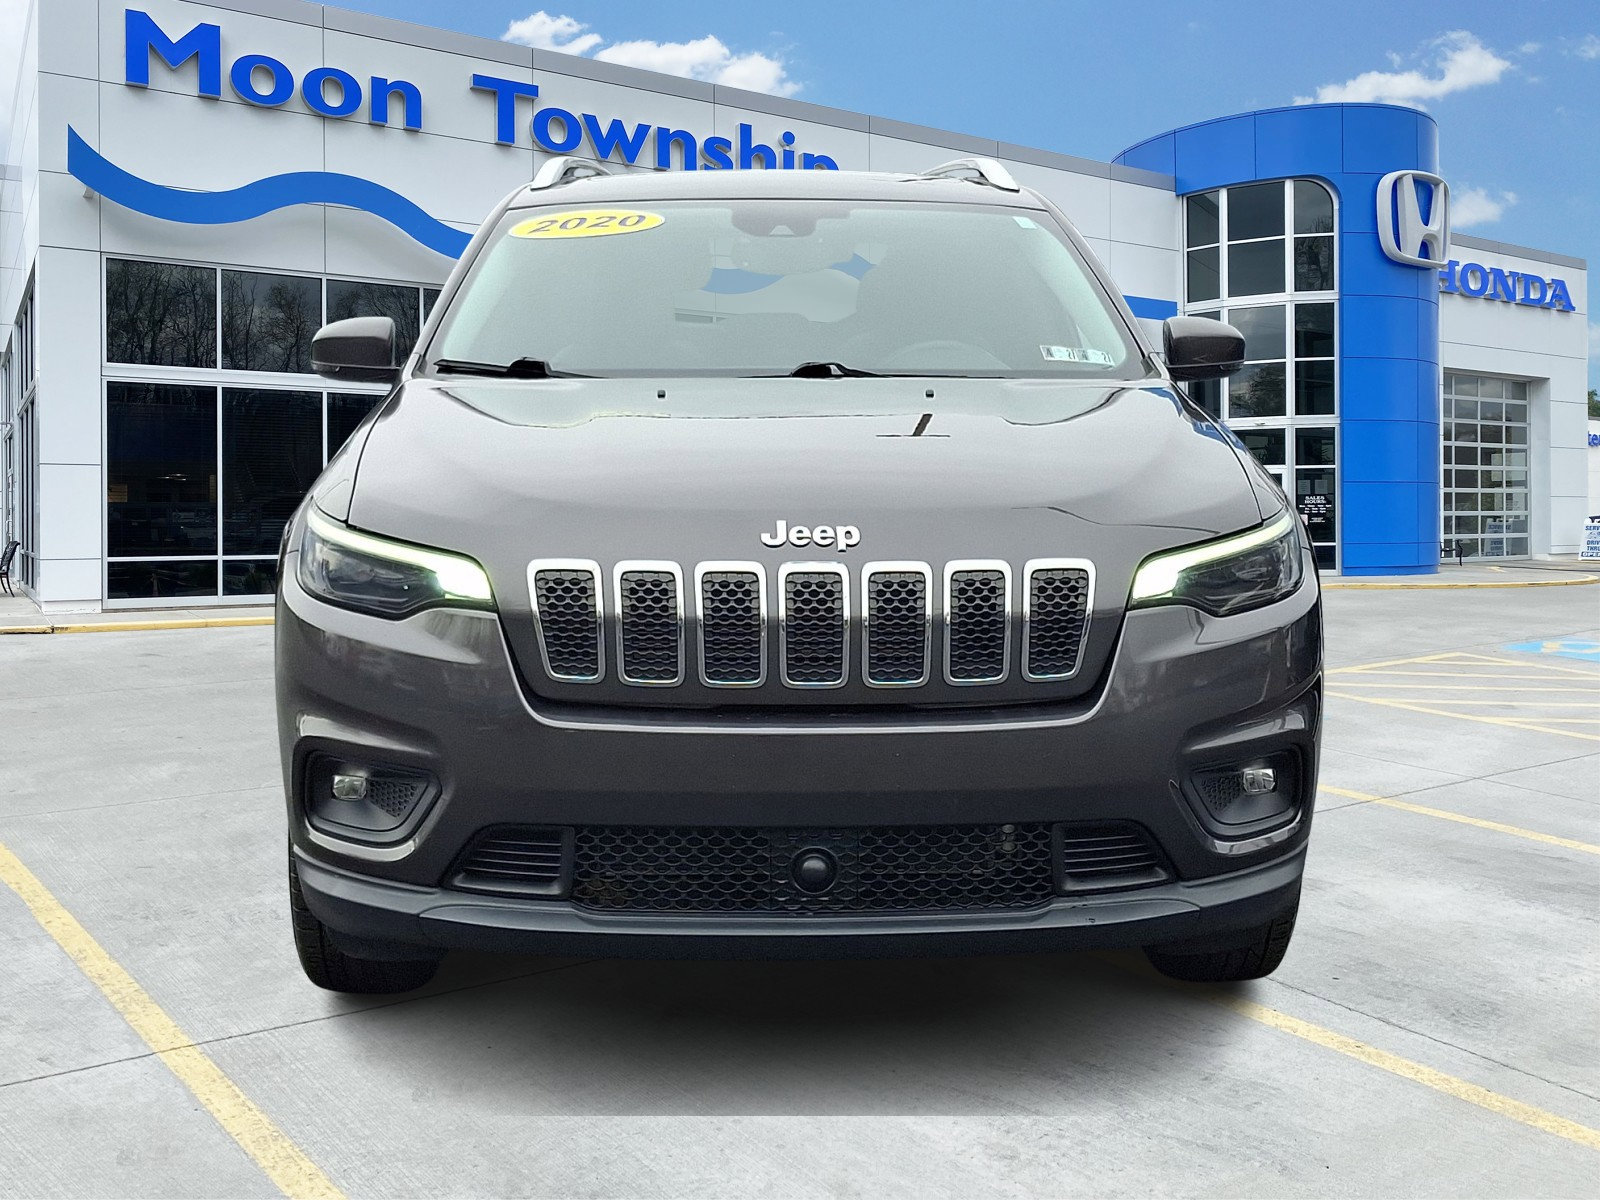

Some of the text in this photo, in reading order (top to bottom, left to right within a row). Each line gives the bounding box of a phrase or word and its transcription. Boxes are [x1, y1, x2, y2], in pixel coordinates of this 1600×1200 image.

[125, 9, 422, 132] Moon
[528, 214, 647, 235] 2020
[760, 519, 861, 553] Jeep
